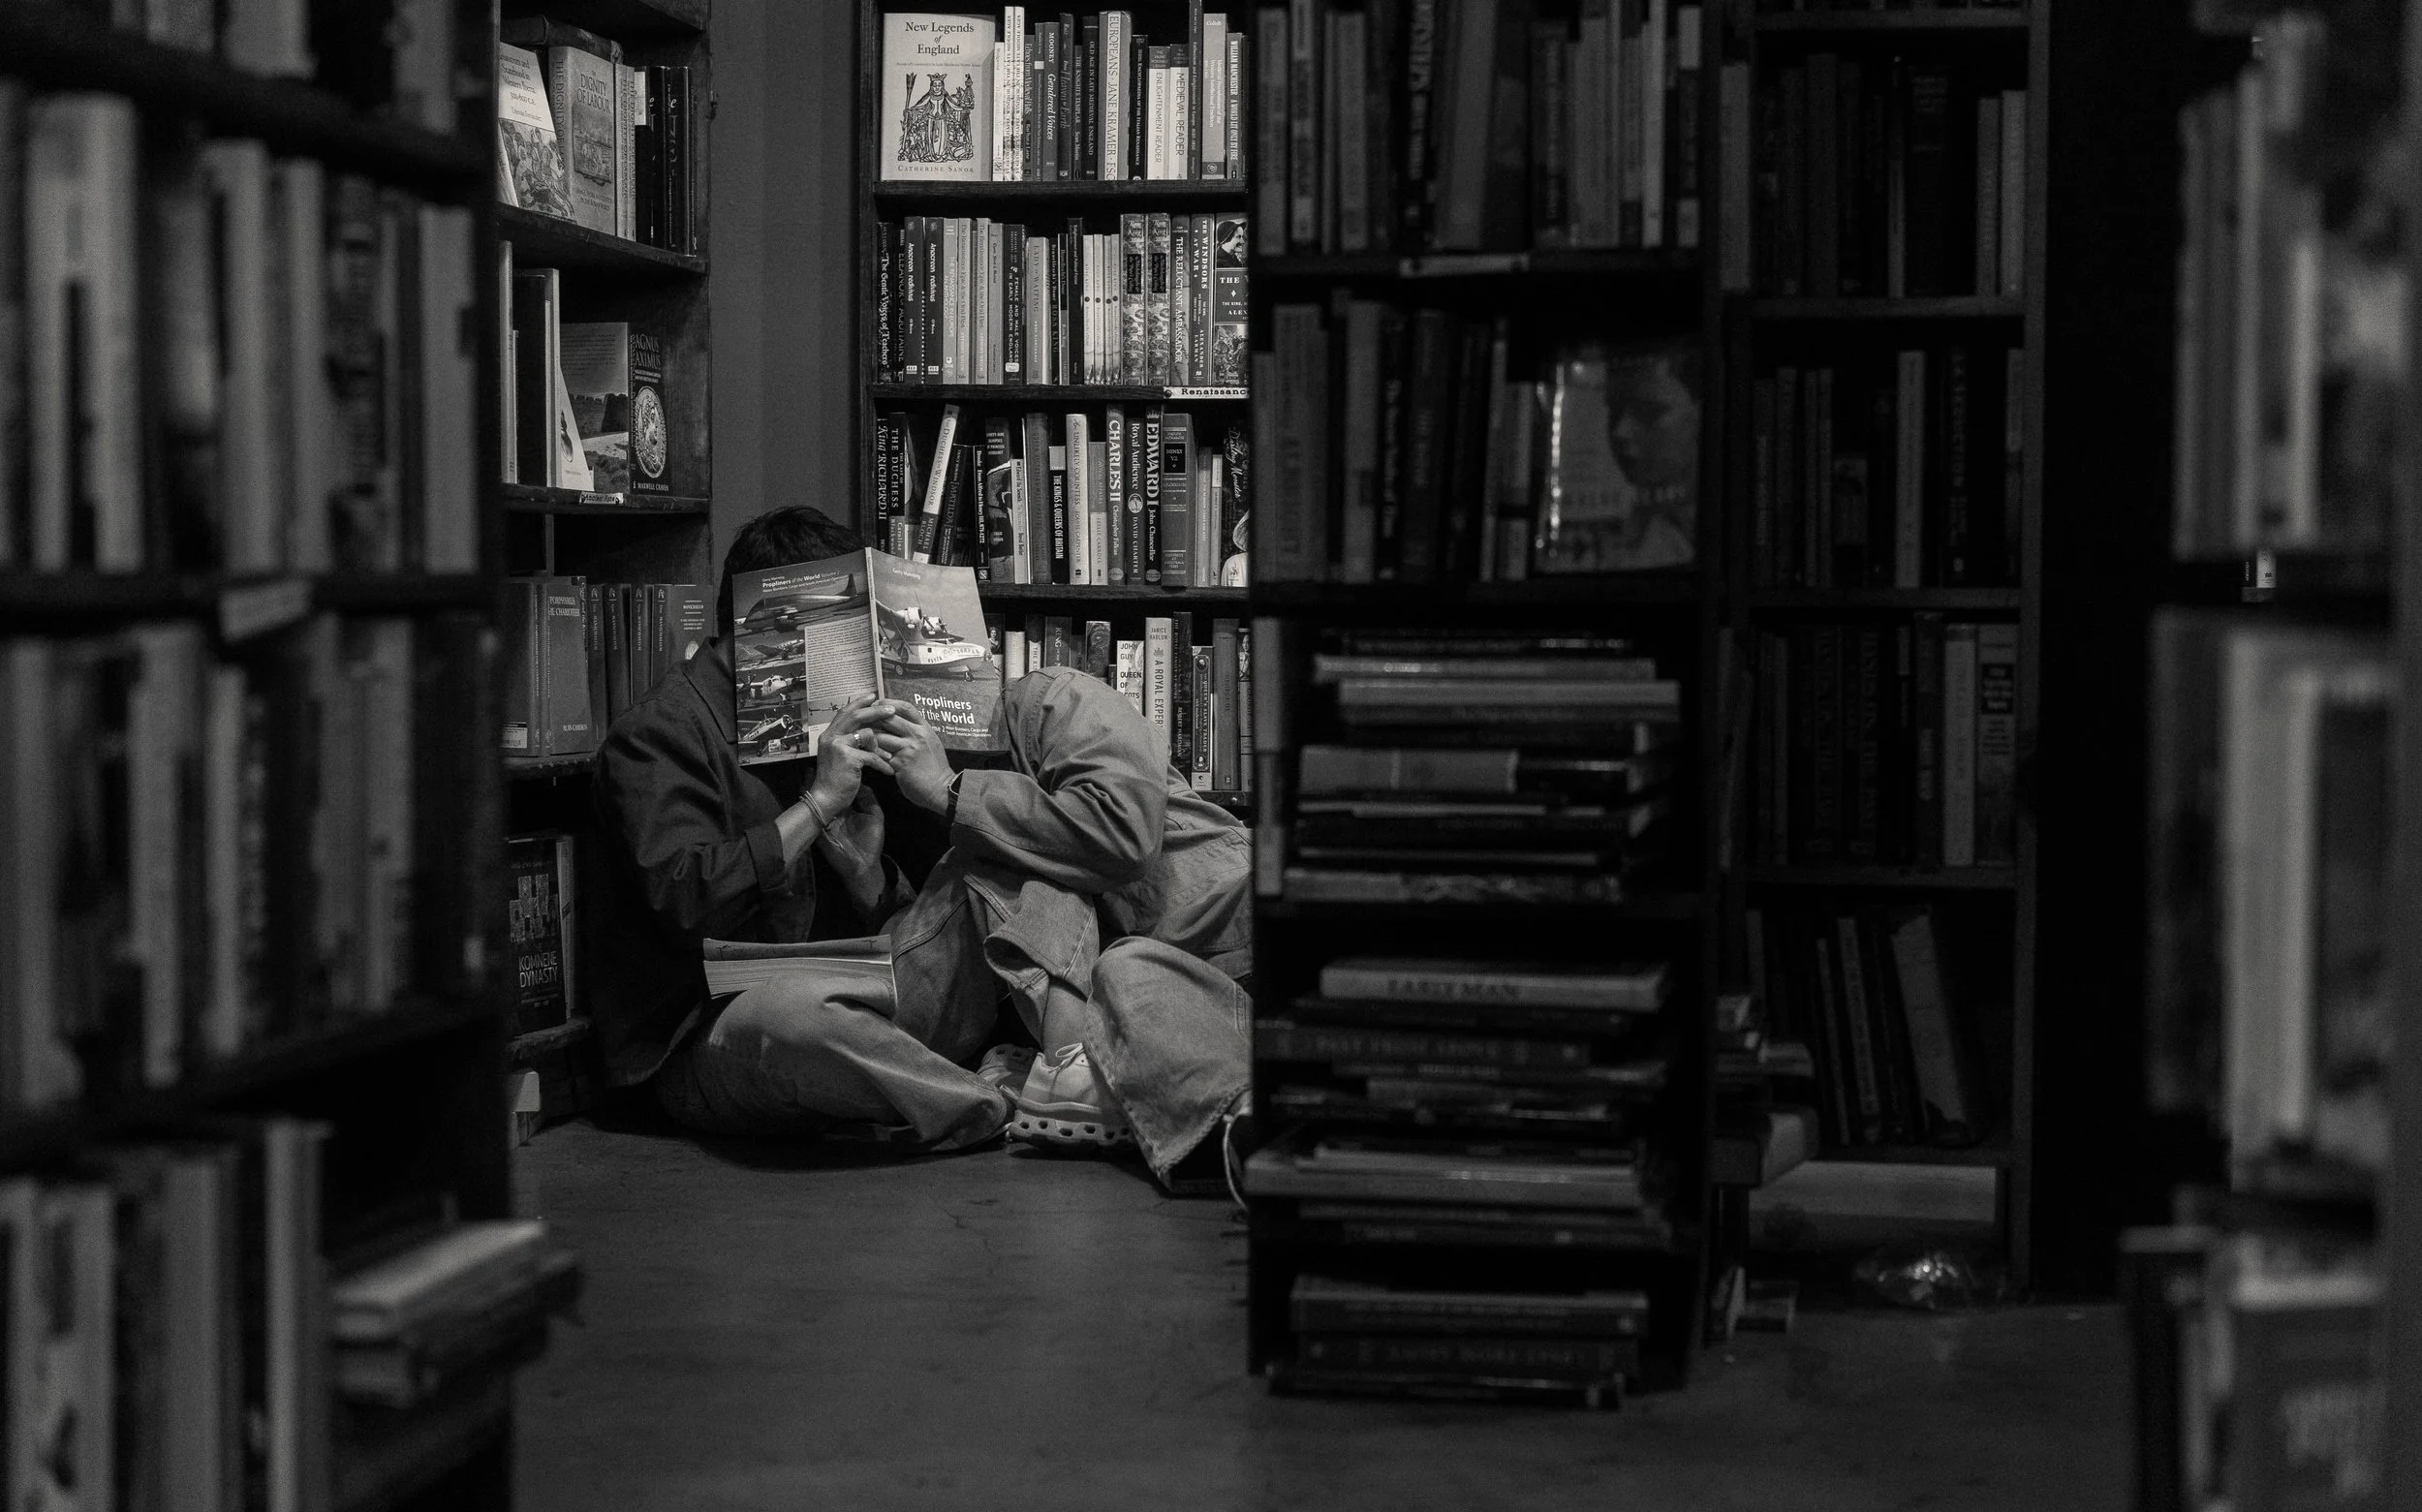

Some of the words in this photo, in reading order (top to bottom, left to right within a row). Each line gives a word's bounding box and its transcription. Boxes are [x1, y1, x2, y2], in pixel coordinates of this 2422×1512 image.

[905, 22, 929, 31] New
[931, 22, 974, 34] Legends
[934, 35, 942, 44] of
[917, 44, 960, 56] England
[1107, 16, 1118, 76] EUROPEANS
[556, 60, 564, 79] THE
[581, 74, 607, 96] DIGNITY
[1047, 74, 1056, 113] Gendered
[1060, 71, 1070, 101] Heaven
[1107, 82, 1118, 108] JANE
[1176, 73, 1185, 116] MEDIEVAL
[556, 82, 564, 127] DIGNITY
[577, 89, 585, 104] OF
[587, 93, 611, 113] LABOUR
[1047, 115, 1056, 140] Voices
[1060, 106, 1070, 129] Earth
[1107, 111, 1118, 155] KRAMER
[1176, 120, 1185, 155] READER
[898, 164, 945, 173] CATHERINE
[947, 164, 975, 173] SANOK
[1193, 238, 1198, 247] AT
[881, 273, 890, 296] Gentle
[879, 297, 890, 322] Voices
[1175, 309, 1183, 363] AMBASSADOR
[877, 426, 887, 451] King
[937, 428, 950, 465] DUCHESS
[1131, 423, 1140, 447] Royal
[1225, 429, 1243, 463] Darling
[1109, 420, 1121, 490] CHARLES
[1147, 423, 1159, 497] EDWARD
[1131, 448, 1140, 489] Audience
[877, 454, 887, 510] RICHARD
[928, 469, 943, 506] WINDSOR
[1231, 466, 1243, 498] Monster
[1109, 492, 1121, 501] II
[877, 512, 887, 520] II
[917, 520, 927, 545] BLOCH
[922, 518, 934, 550] MICHAEL
[763, 580, 791, 588] Propliners
[1155, 669, 1163, 695] ROYAL
[914, 694, 972, 710] Propliners
[927, 712, 940, 721] the
[941, 710, 975, 724] World
[519, 951, 557, 971] KOMNENE
[520, 967, 558, 988] DYNASTY
[1463, 981, 1522, 1000] MAN
